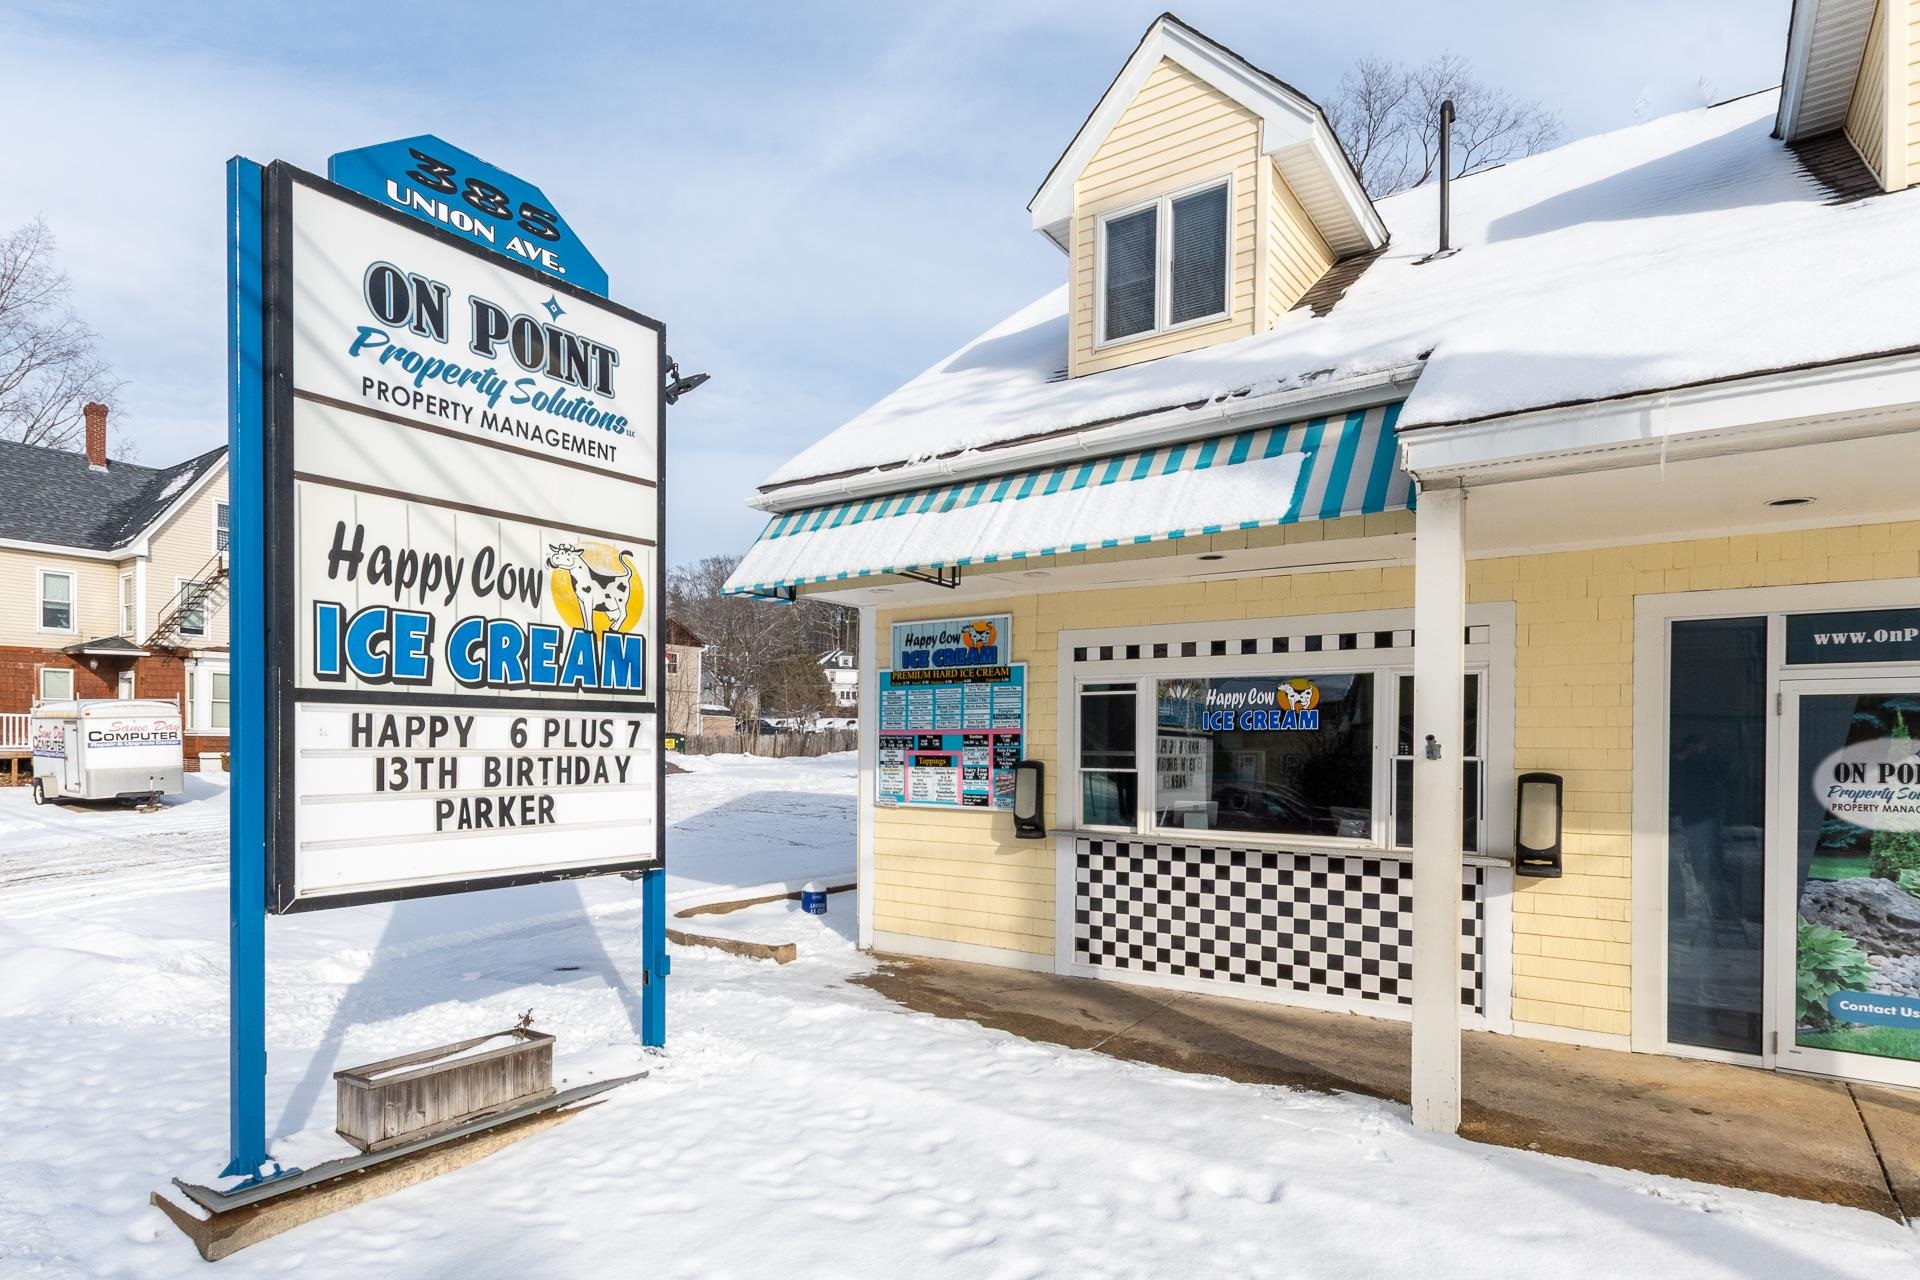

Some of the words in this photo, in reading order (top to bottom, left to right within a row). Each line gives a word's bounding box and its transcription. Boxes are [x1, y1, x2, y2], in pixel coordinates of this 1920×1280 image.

[405, 147, 560, 241] 385
[386, 179, 495, 243] UNION
[506, 236, 566, 274] AVE.
[364, 261, 449, 342] ON
[469, 295, 619, 399] POINT
[348, 325, 508, 410] Property
[510, 378, 628, 436] Solutions
[362, 376, 474, 425] PROPERTY
[481, 414, 617, 463] MANAGEMENT
[328, 521, 464, 607] Happy
[471, 545, 543, 609] Cow
[313, 600, 436, 687] ICE
[444, 615, 647, 696] CREAM
[905, 632, 939, 649] Happy
[939, 631, 961, 645] Cow
[902, 649, 930, 668] ICE
[931, 646, 998, 667] CREAM
[892, 670, 931, 681] PREMIUM
[933, 669, 959, 679] HARD
[960, 669, 974, 678] ICE
[976, 667, 1009, 678] CREAM
[1206, 687, 1246, 709] Happy
[1247, 687, 1275, 706] Cow
[109, 721, 148, 732] Same
[154, 720, 181, 732] Day
[351, 712, 475, 748] HAPPY
[510, 718, 528, 748] 6
[543, 719, 614, 748] PLUS
[627, 721, 641, 748] 7
[1202, 710, 1234, 731] ICE
[1239, 709, 1319, 730] CREAM
[375, 757, 458, 791] 13TH
[484, 755, 631, 788] BIRTHDAY
[918, 757, 946, 768] Toppings
[1834, 762, 1866, 783] ON
[1827, 785, 1895, 804] Property
[436, 795, 556, 831] PARKER
[1832, 803, 1879, 812] PROPERTY
[1839, 1000, 1897, 1015] Contact
[1900, 1007, 1920, 1018] Us
